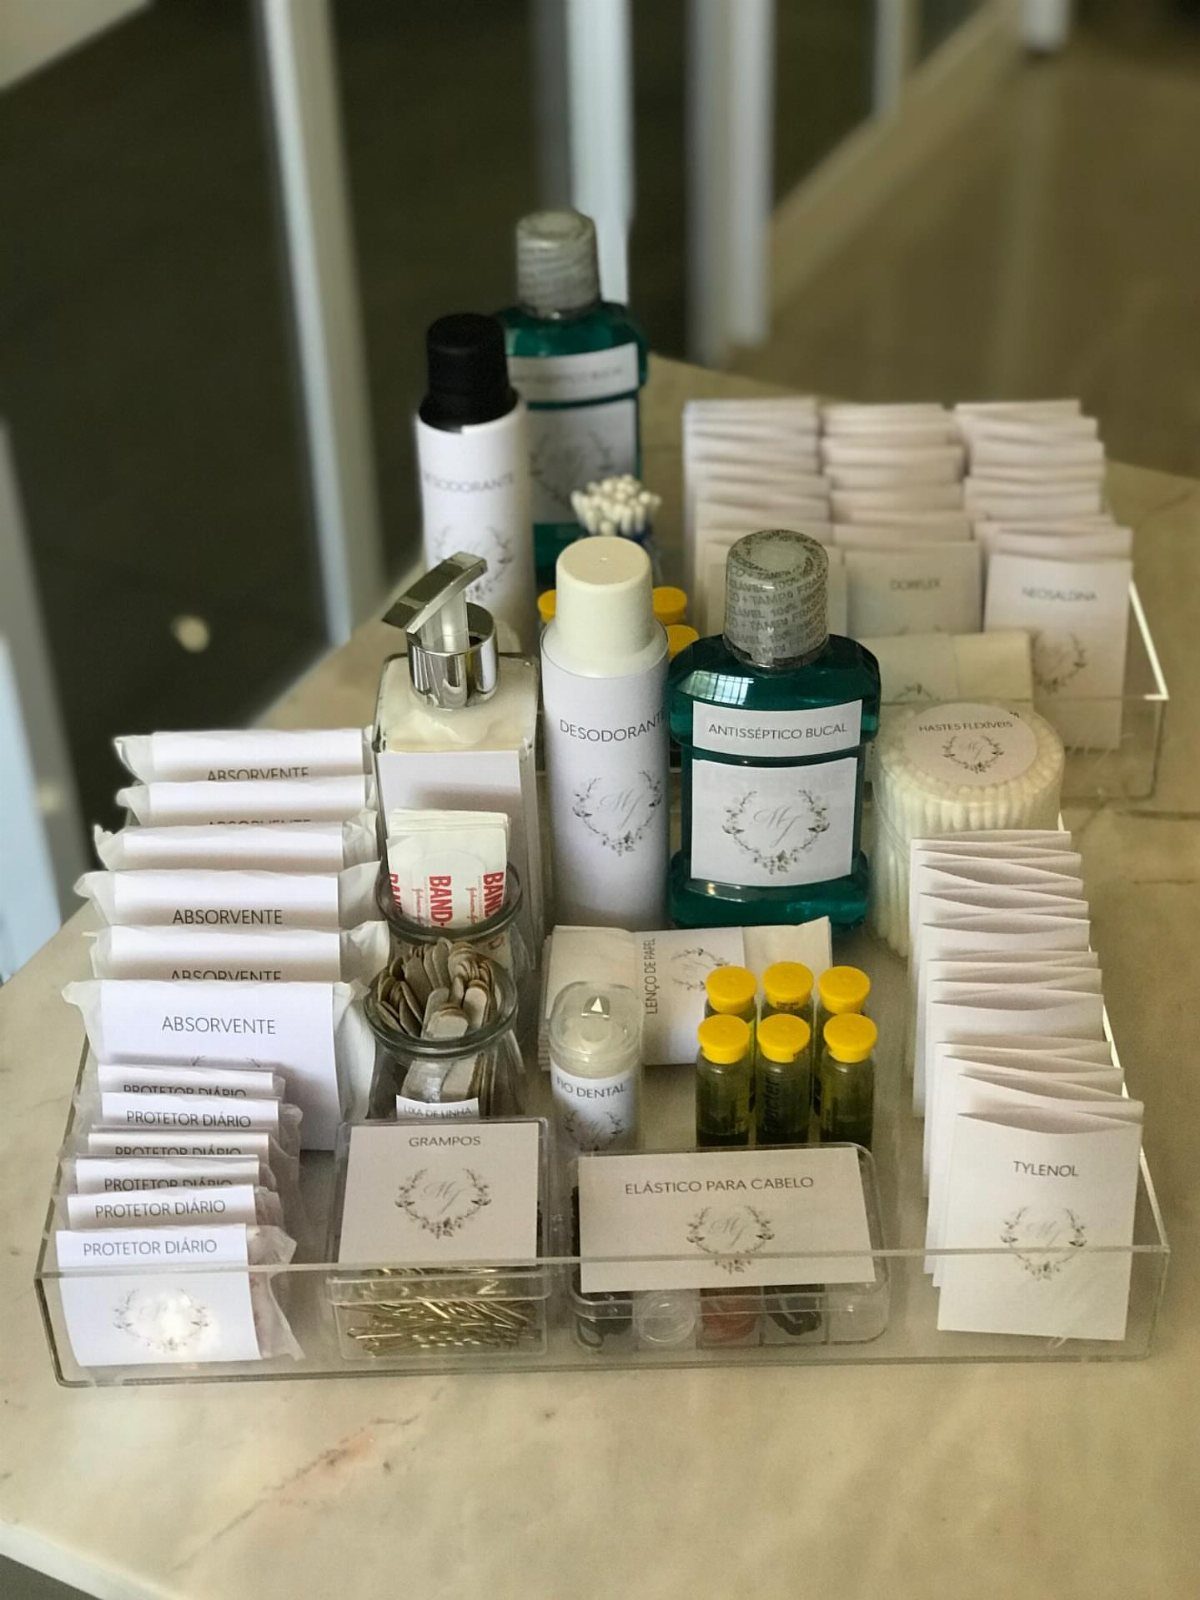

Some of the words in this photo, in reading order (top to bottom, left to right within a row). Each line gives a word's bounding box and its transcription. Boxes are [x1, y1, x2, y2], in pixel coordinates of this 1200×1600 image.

[708, 723, 802, 740] ANTISSÉPTICO
[805, 723, 848, 739] BUCAL
[172, 909, 284, 925] ABSORVENTE
[643, 960, 656, 974] DE
[644, 975, 660, 1015] LENÇO
[162, 1015, 276, 1035] ABSORVENTE
[576, 1082, 625, 1098] DENTAL
[126, 1110, 199, 1126] PROTETOR
[202, 1110, 252, 1129] DIÁRIO
[408, 1135, 481, 1148] GRAMPOS
[1013, 1160, 1080, 1178] TYLENOL
[104, 1178, 179, 1192] PROTETOR
[625, 1180, 702, 1195] ELÁSTICO
[706, 1179, 748, 1191] PARA
[751, 1176, 815, 1190] CABELO
[95, 1202, 172, 1219] PROTETOR
[174, 1197, 226, 1215] DIÁRIO
[83, 1240, 161, 1257] PROTETOR
[165, 1236, 217, 1254] DIÁRIO
